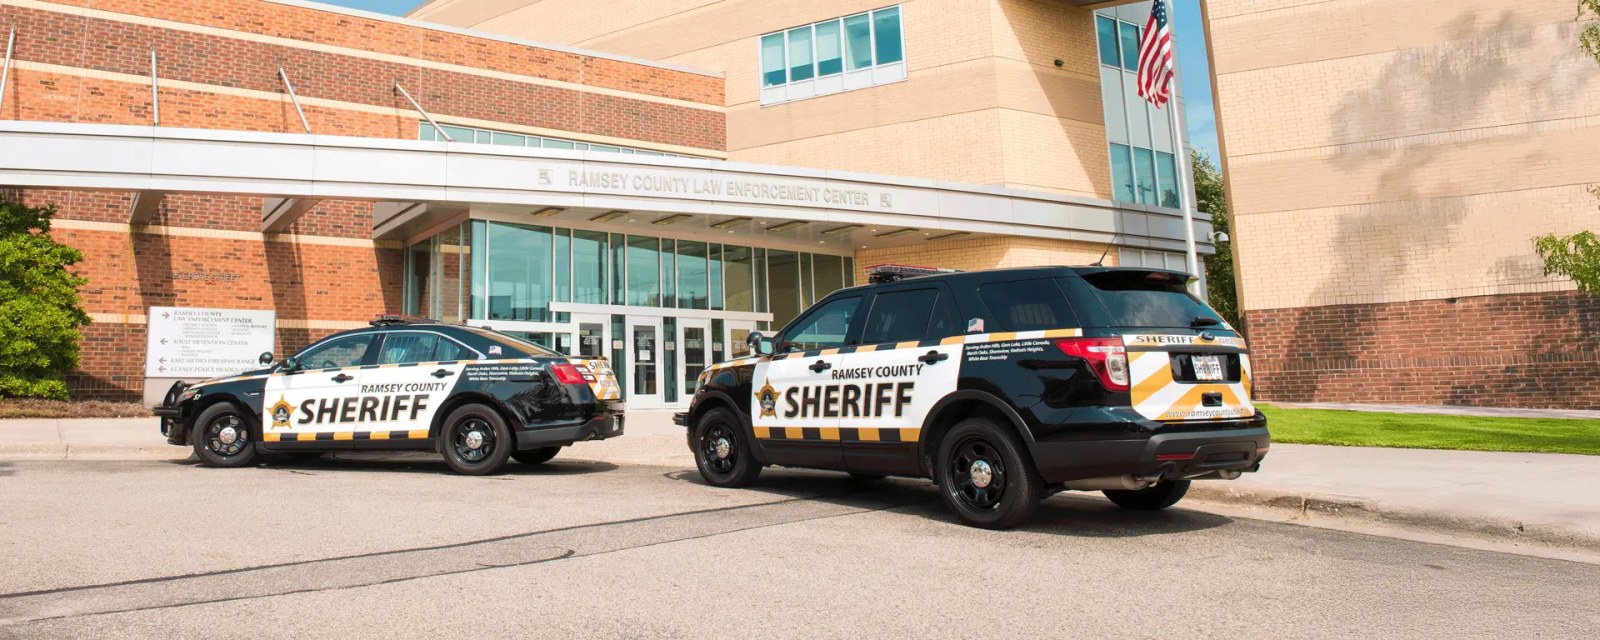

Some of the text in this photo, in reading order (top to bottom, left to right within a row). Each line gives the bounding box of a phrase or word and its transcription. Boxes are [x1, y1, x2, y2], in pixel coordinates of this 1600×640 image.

[569, 170, 869, 206] RAMSEY COUNTY LAW ENFORCEMENT CENTER
[1136, 335, 1195, 344] SHERIFF
[832, 363, 924, 380] RAMSEY COUNTY
[361, 382, 447, 394] RAMSEY COUNTY
[784, 381, 915, 418] SHERIFF
[298, 394, 429, 425] SHERIFF
